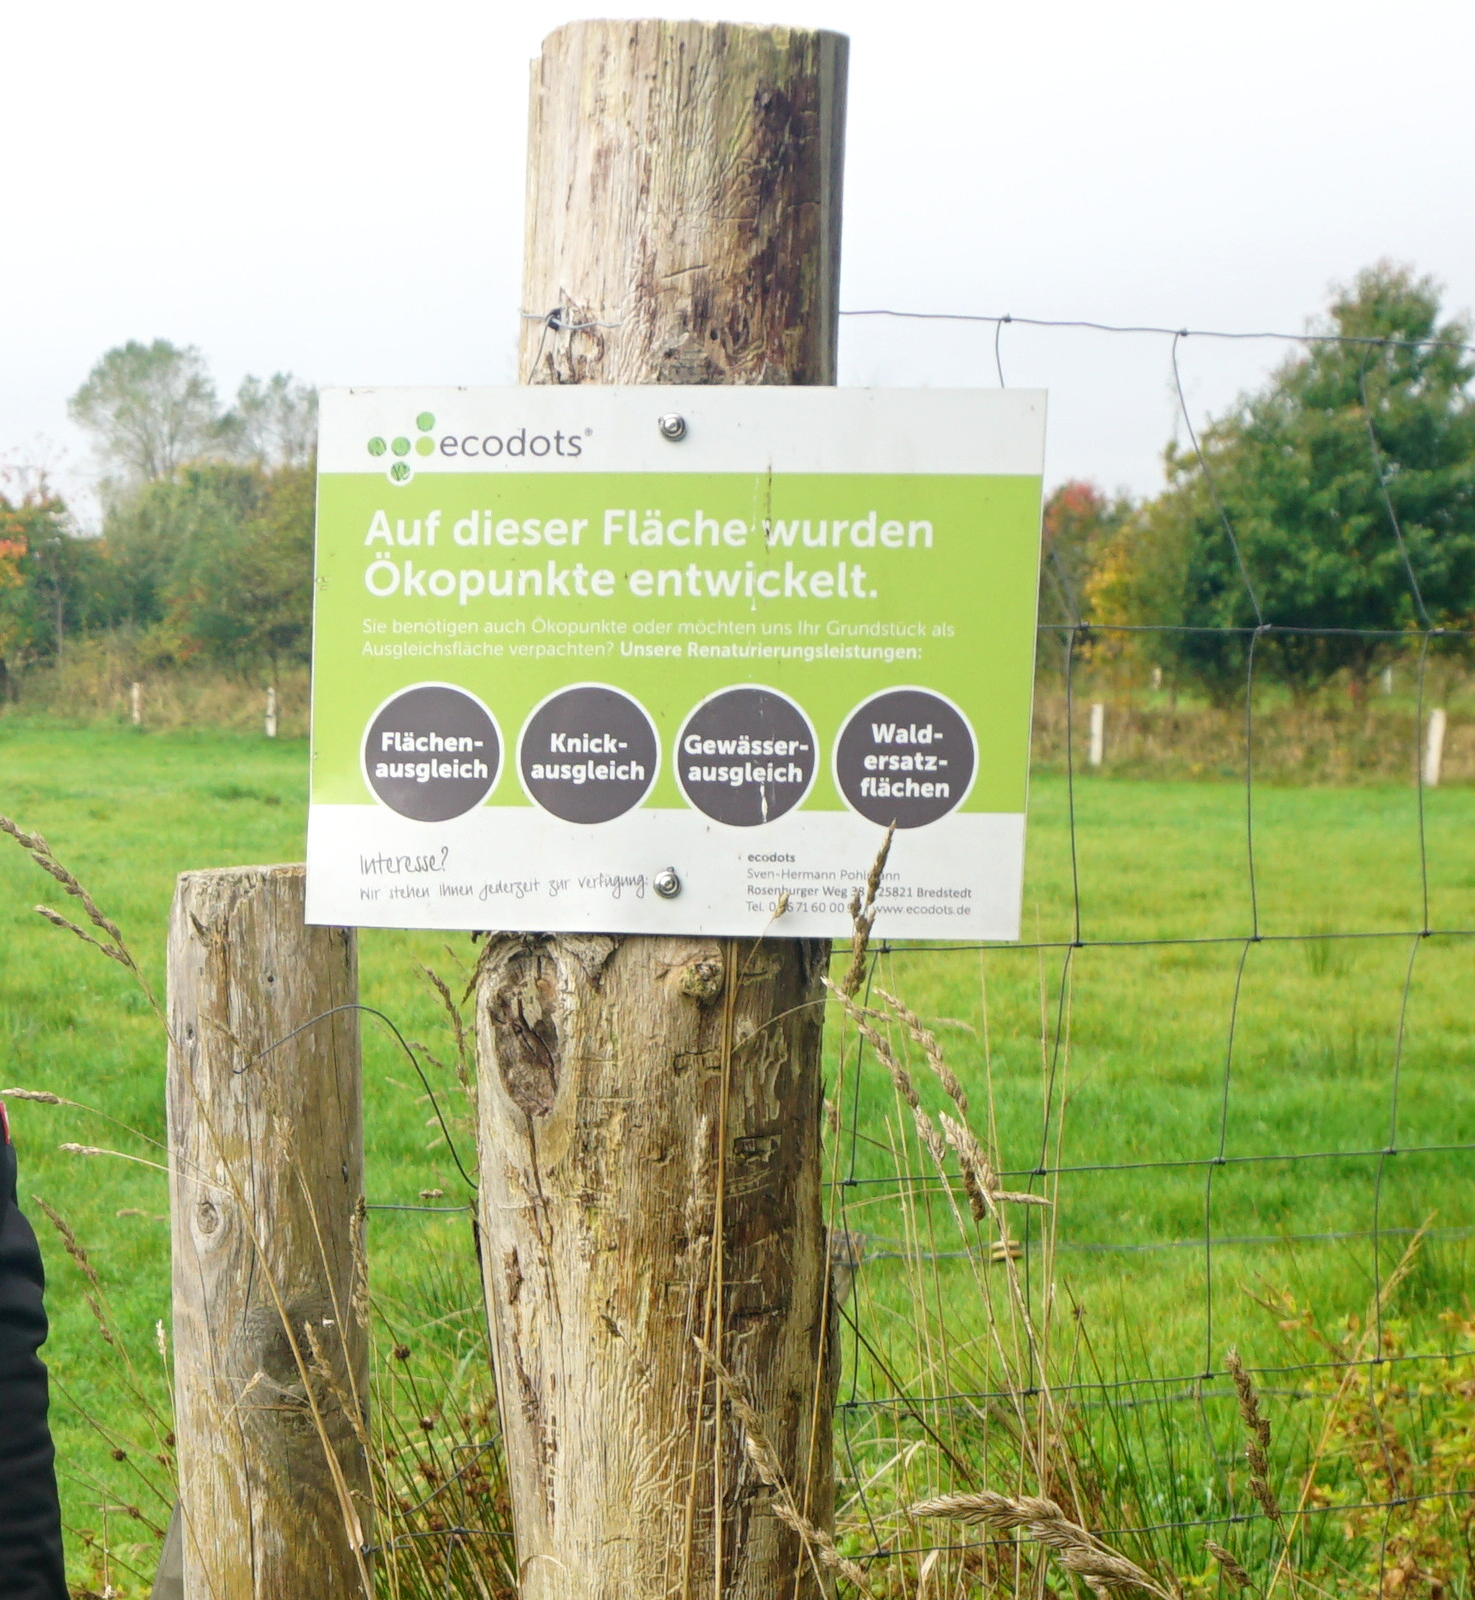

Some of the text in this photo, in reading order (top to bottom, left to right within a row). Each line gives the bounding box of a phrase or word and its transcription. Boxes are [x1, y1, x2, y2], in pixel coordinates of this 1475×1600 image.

[364, 509, 933, 548] Auf dieser Fläche wurden
[365, 551, 878, 606] Ökopunkte entwickelt.
[362, 617, 955, 639] Sie benötigen auch Ökopunkte oder möchten uns Ihr Grundstück als
[361, 641, 922, 663] Ausgleichsfläche verpachten? Unsere Renaturierungsleistungen:
[381, 732, 483, 752] Flächen-
[550, 733, 628, 753] Knick-
[872, 723, 943, 744] Wald-
[684, 734, 809, 756] Gewässer-
[375, 759, 488, 782] ausgleich
[531, 761, 645, 784] ausgleich
[864, 752, 948, 771] ersatz-
[688, 763, 803, 786] ausgleich
[860, 777, 949, 798] flächen
[360, 846, 449, 875] Interesse?
[747, 852, 796, 863] ecodots
[747, 868, 836, 880] Sven-Hermann
[360, 887, 381, 900] Wir
[389, 885, 430, 900] stehen
[439, 882, 474, 896] Ihnen
[479, 879, 540, 901] jederzeit
[549, 878, 570, 897] zur
[822, 886, 847, 899] Weg
[878, 887, 912, 897] 25821
[917, 888, 972, 899] Bredstedt
[746, 901, 764, 912] Tel.
[873, 904, 971, 916] www.ecodots.de
